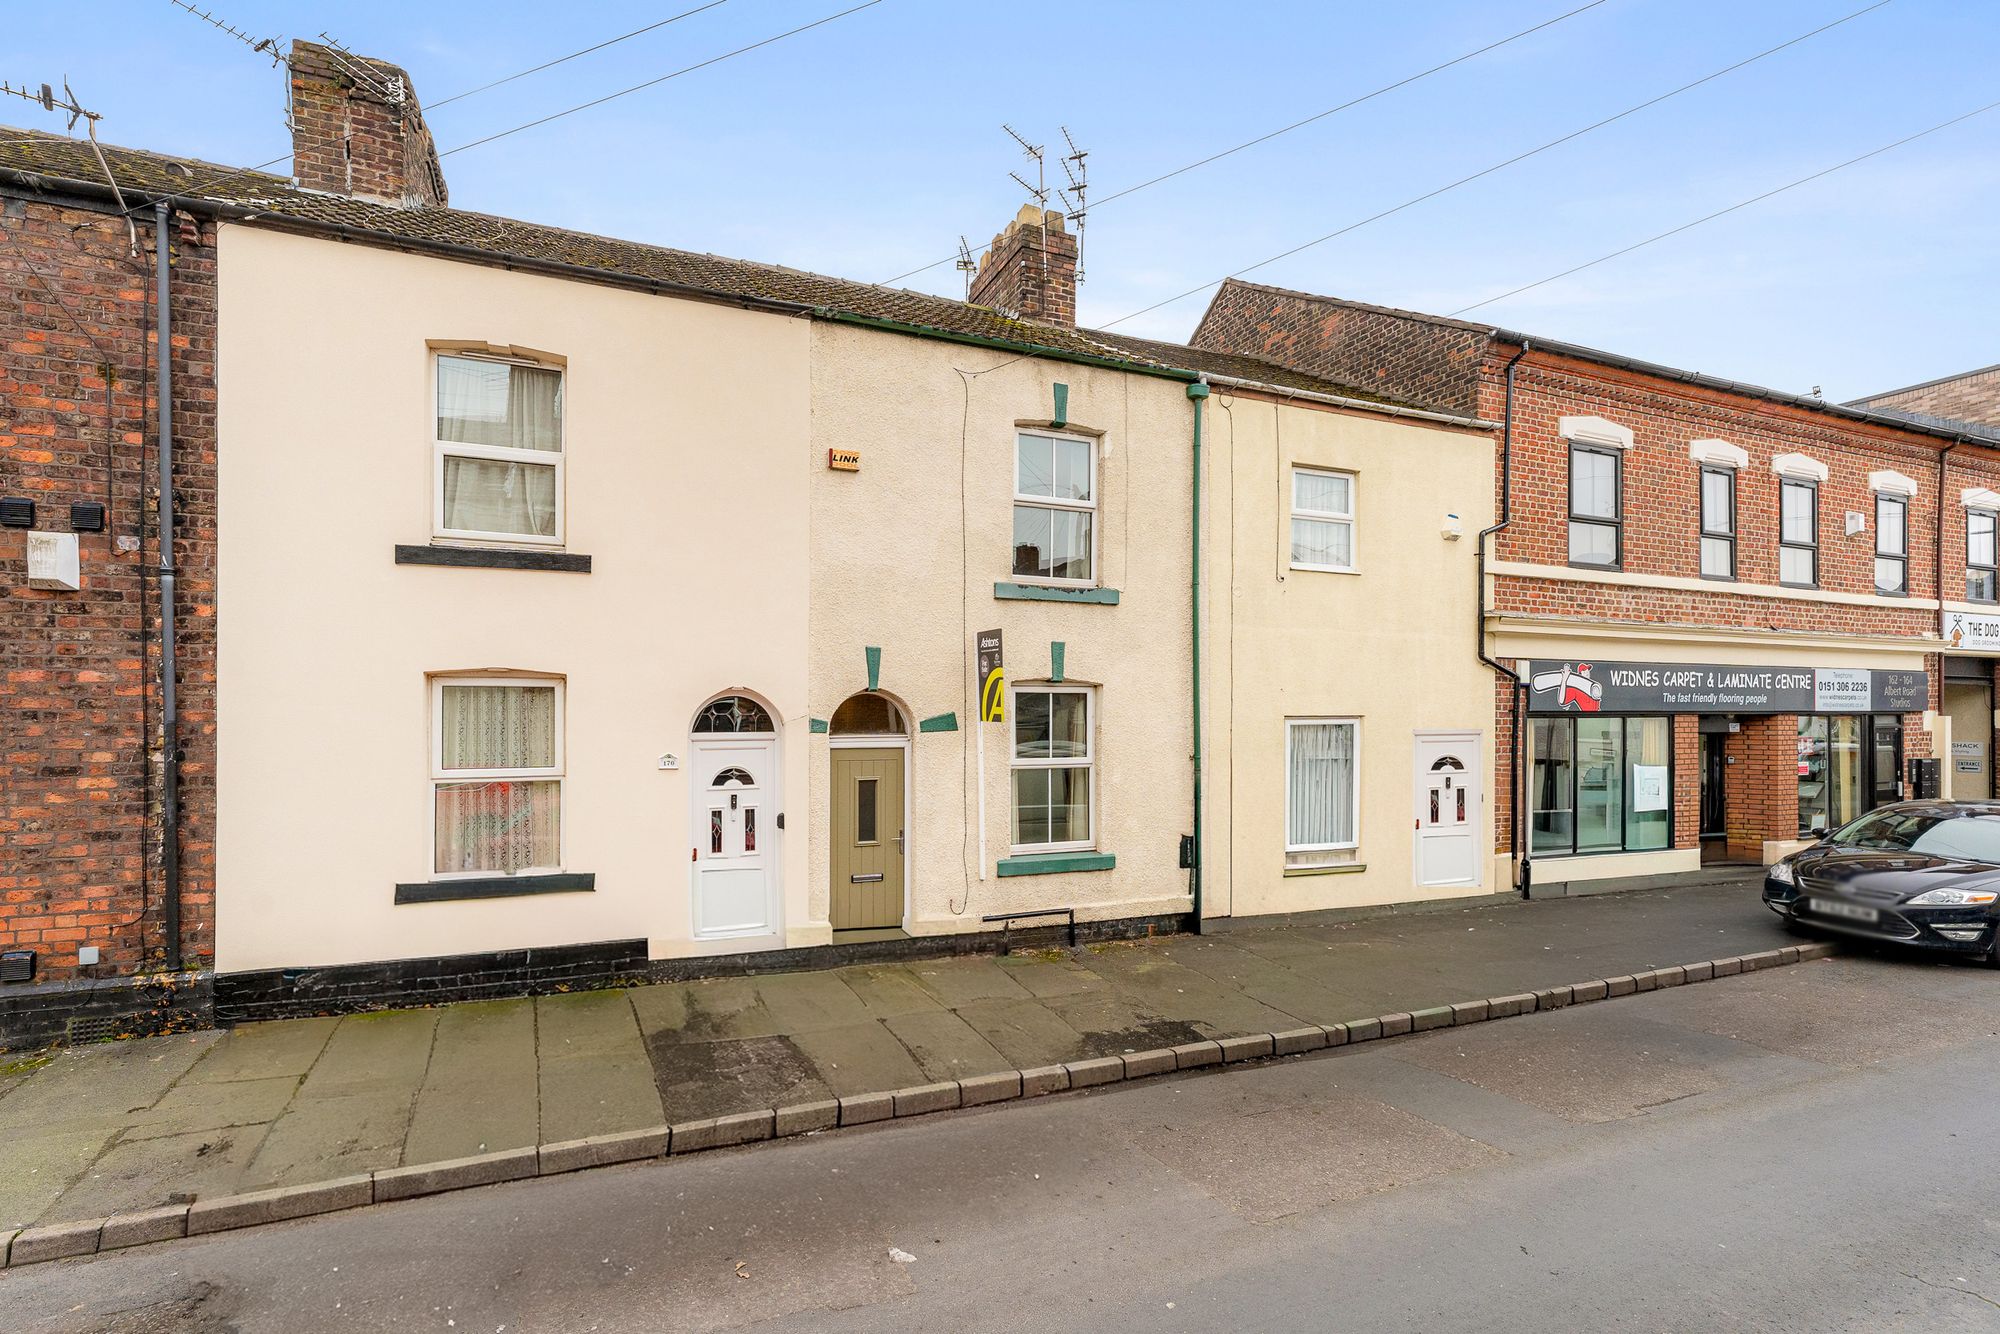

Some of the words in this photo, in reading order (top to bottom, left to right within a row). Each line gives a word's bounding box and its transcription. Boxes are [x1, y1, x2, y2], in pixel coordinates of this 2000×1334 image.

[832, 454, 859, 463] LINK
[1968, 622, 1982, 636] THE
[1984, 623, 1999, 637] DOG
[1610, 669, 1659, 687] WIDNES
[1663, 671, 1703, 688] CARPET
[1706, 672, 1714, 688] &
[1717, 672, 1772, 689] LAMINATE
[1774, 673, 1811, 690] CENTRE
[1888, 675, 1898, 685] 162
[1903, 675, 1913, 685] 164
[1818, 681, 1835, 691] 0151
[1836, 681, 1850, 691] 306
[1850, 682, 1868, 692] 2236
[1902, 686, 1917, 697] Road
[1663, 692, 1676, 702] The
[1677, 692, 1691, 702] fast
[1692, 692, 1717, 705] friendly
[1718, 693, 1744, 706] flooring
[1745, 694, 1767, 705] people
